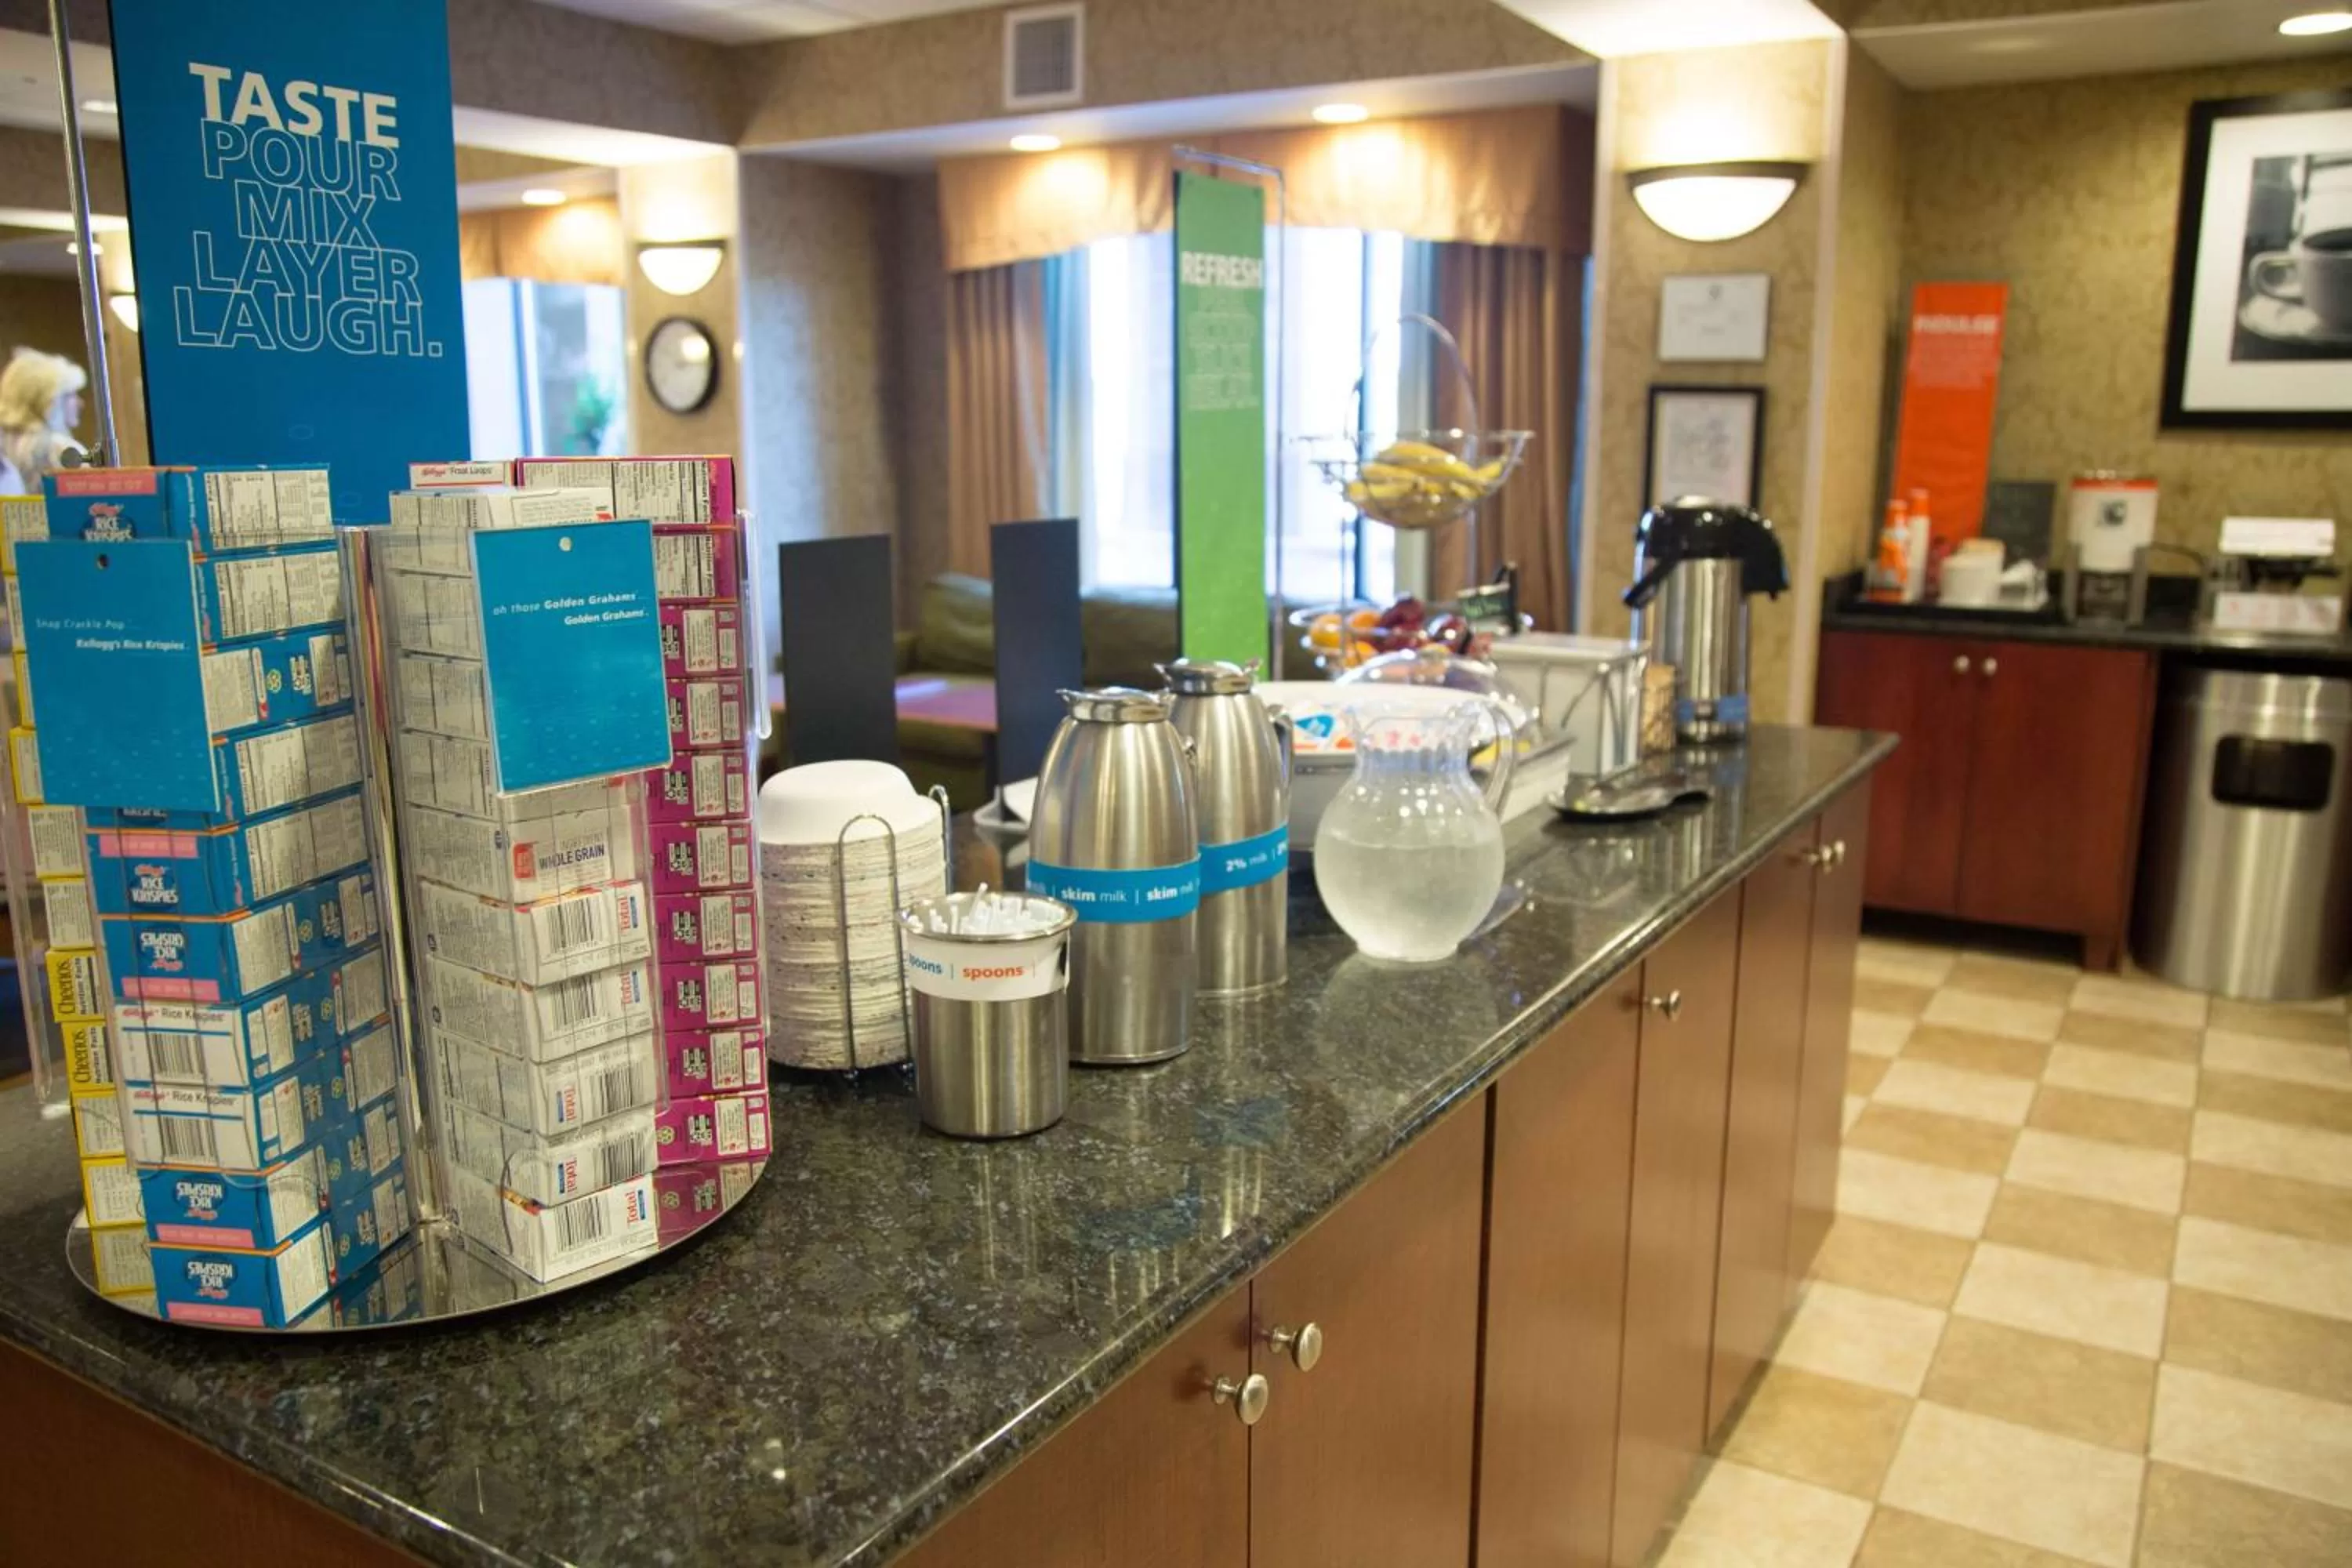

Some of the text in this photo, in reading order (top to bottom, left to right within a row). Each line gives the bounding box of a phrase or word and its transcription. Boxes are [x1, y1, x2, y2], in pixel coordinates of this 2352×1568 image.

[188, 62, 399, 147] TASTE
[201, 118, 401, 201] POUR
[234, 179, 381, 249] MIX
[193, 230, 423, 306] LAYER
[173, 285, 443, 358] LAUGH.
[493, 592, 637, 615] oh those Golden Grahams
[105, 618, 125, 630] Pop
[564, 614, 601, 626] Golden
[75, 637, 121, 652] Kellogg's
[123, 639, 143, 649] Rice
[539, 850, 575, 870] WHOLE
[575, 844, 605, 862] GRAIN
[1225, 858, 1247, 873] 2%
[1061, 886, 1097, 903] skim
[1099, 890, 1127, 903] milk
[1147, 886, 1178, 902] skim
[962, 964, 1025, 982] spoons
[57, 960, 76, 1014] Cheerios
[162, 1008, 183, 1018] Rice
[72, 1029, 91, 1083] Cheerios
[172, 1091, 193, 1103] Rice
[565, 1157, 578, 1193] Total
